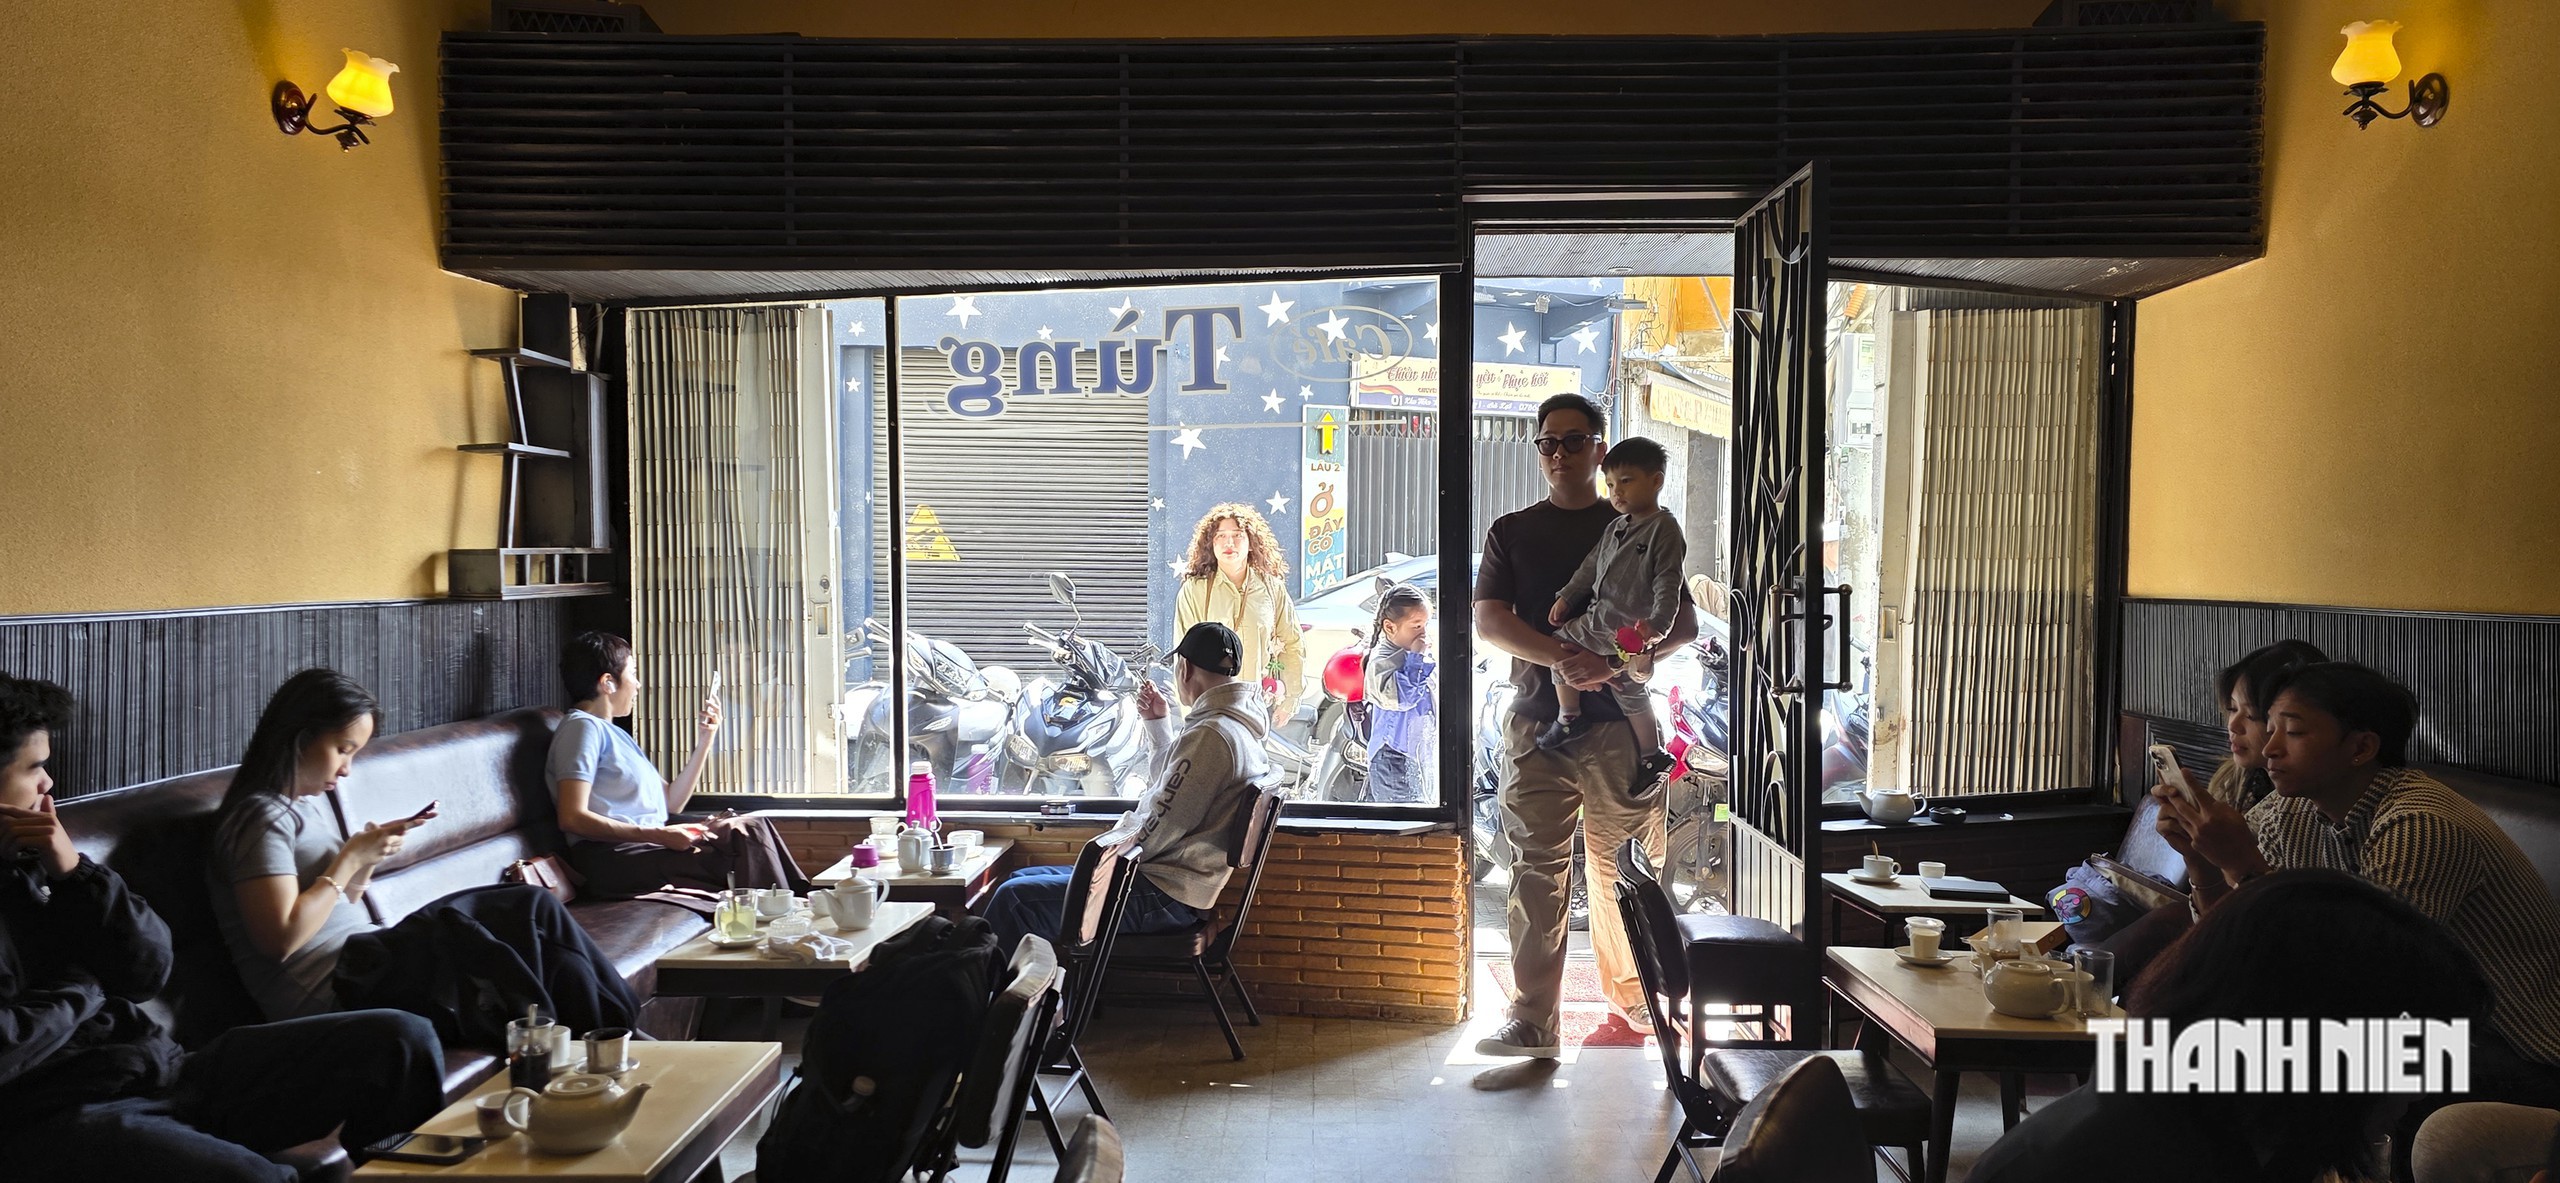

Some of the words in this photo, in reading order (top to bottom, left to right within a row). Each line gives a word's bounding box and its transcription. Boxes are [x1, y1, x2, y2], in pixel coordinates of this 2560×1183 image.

[1334, 463, 1340, 472] 2
[1310, 482, 1334, 518] Ở
[1309, 516, 1343, 539] ĐÂY
[1308, 533, 1333, 555] CÓ
[1306, 552, 1345, 581] MÁT
[1138, 758, 1192, 843] carhar
